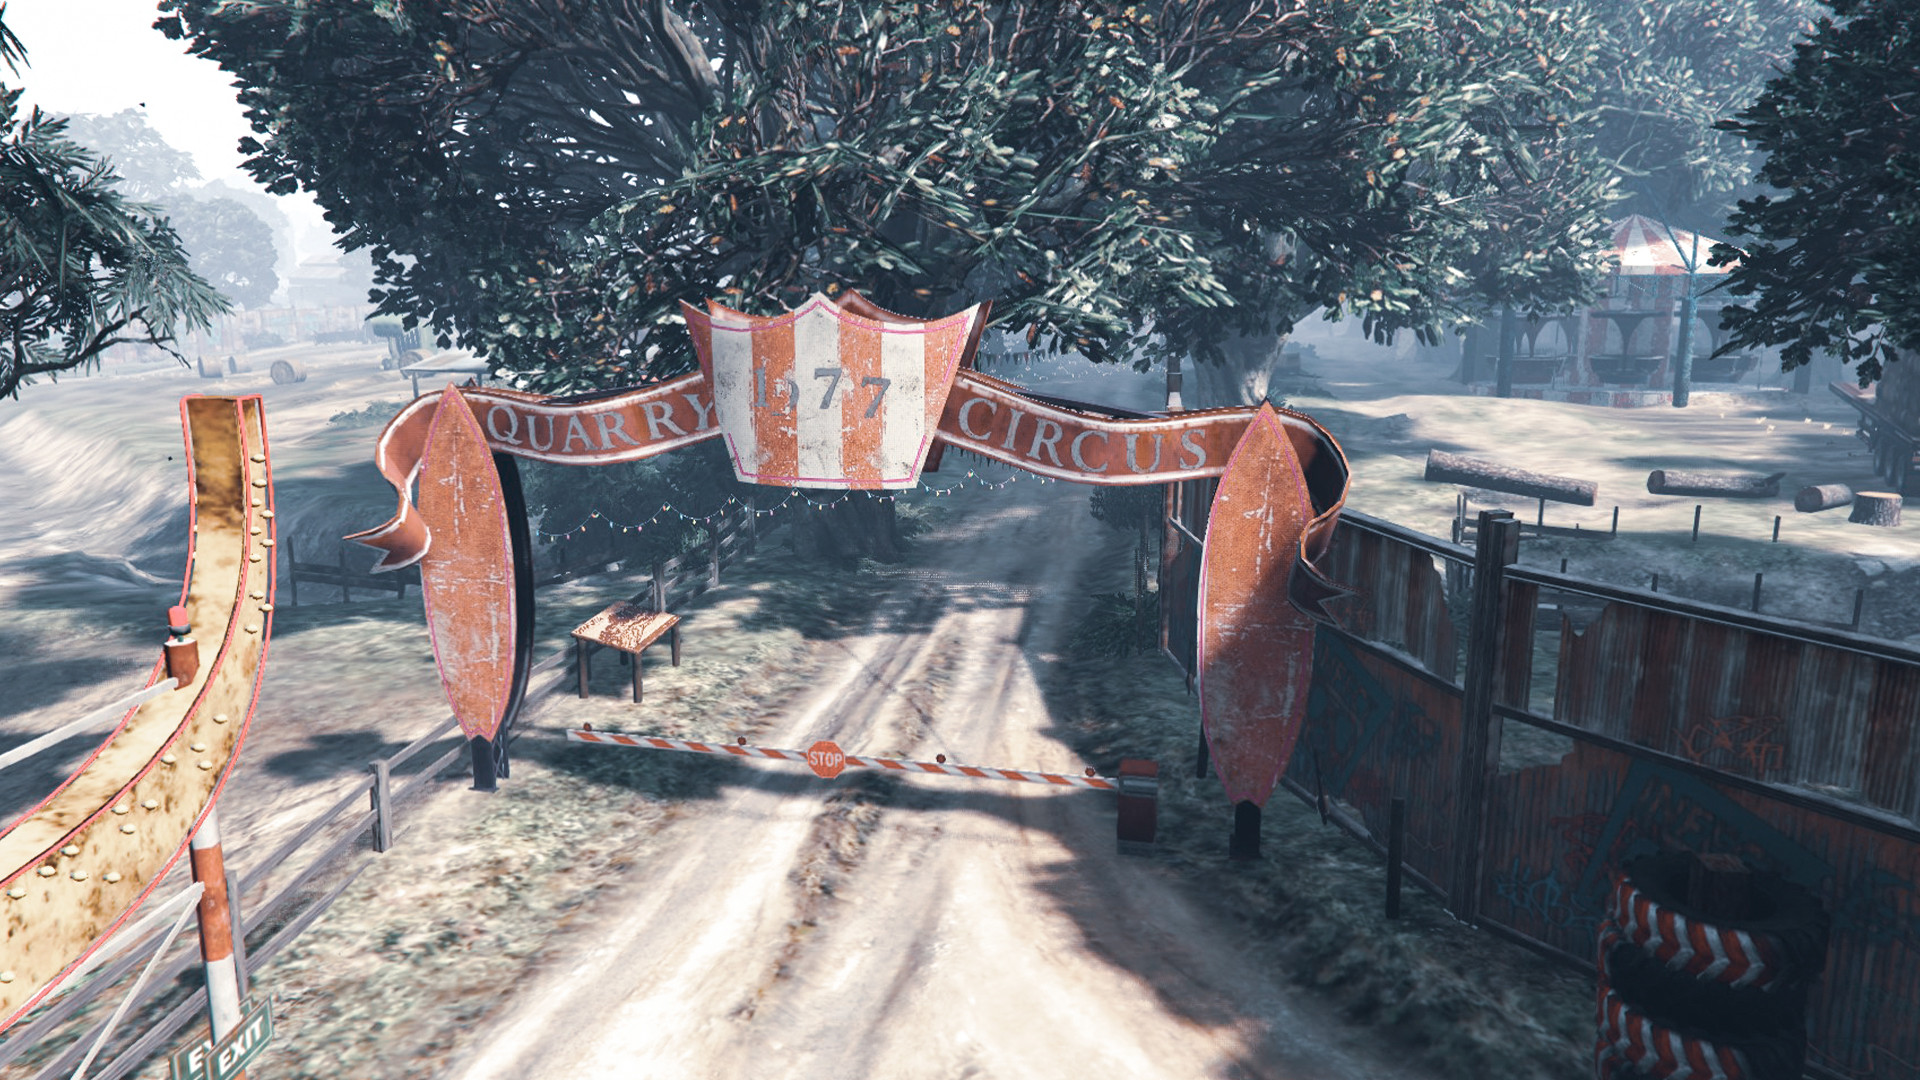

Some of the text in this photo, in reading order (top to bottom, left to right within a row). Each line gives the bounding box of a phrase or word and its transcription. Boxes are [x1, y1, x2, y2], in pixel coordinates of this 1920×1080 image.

[486, 393, 1206, 473] QUARRY CIRCUS
[809, 751, 843, 767] STOP
[218, 1015, 263, 1076] EXIT
